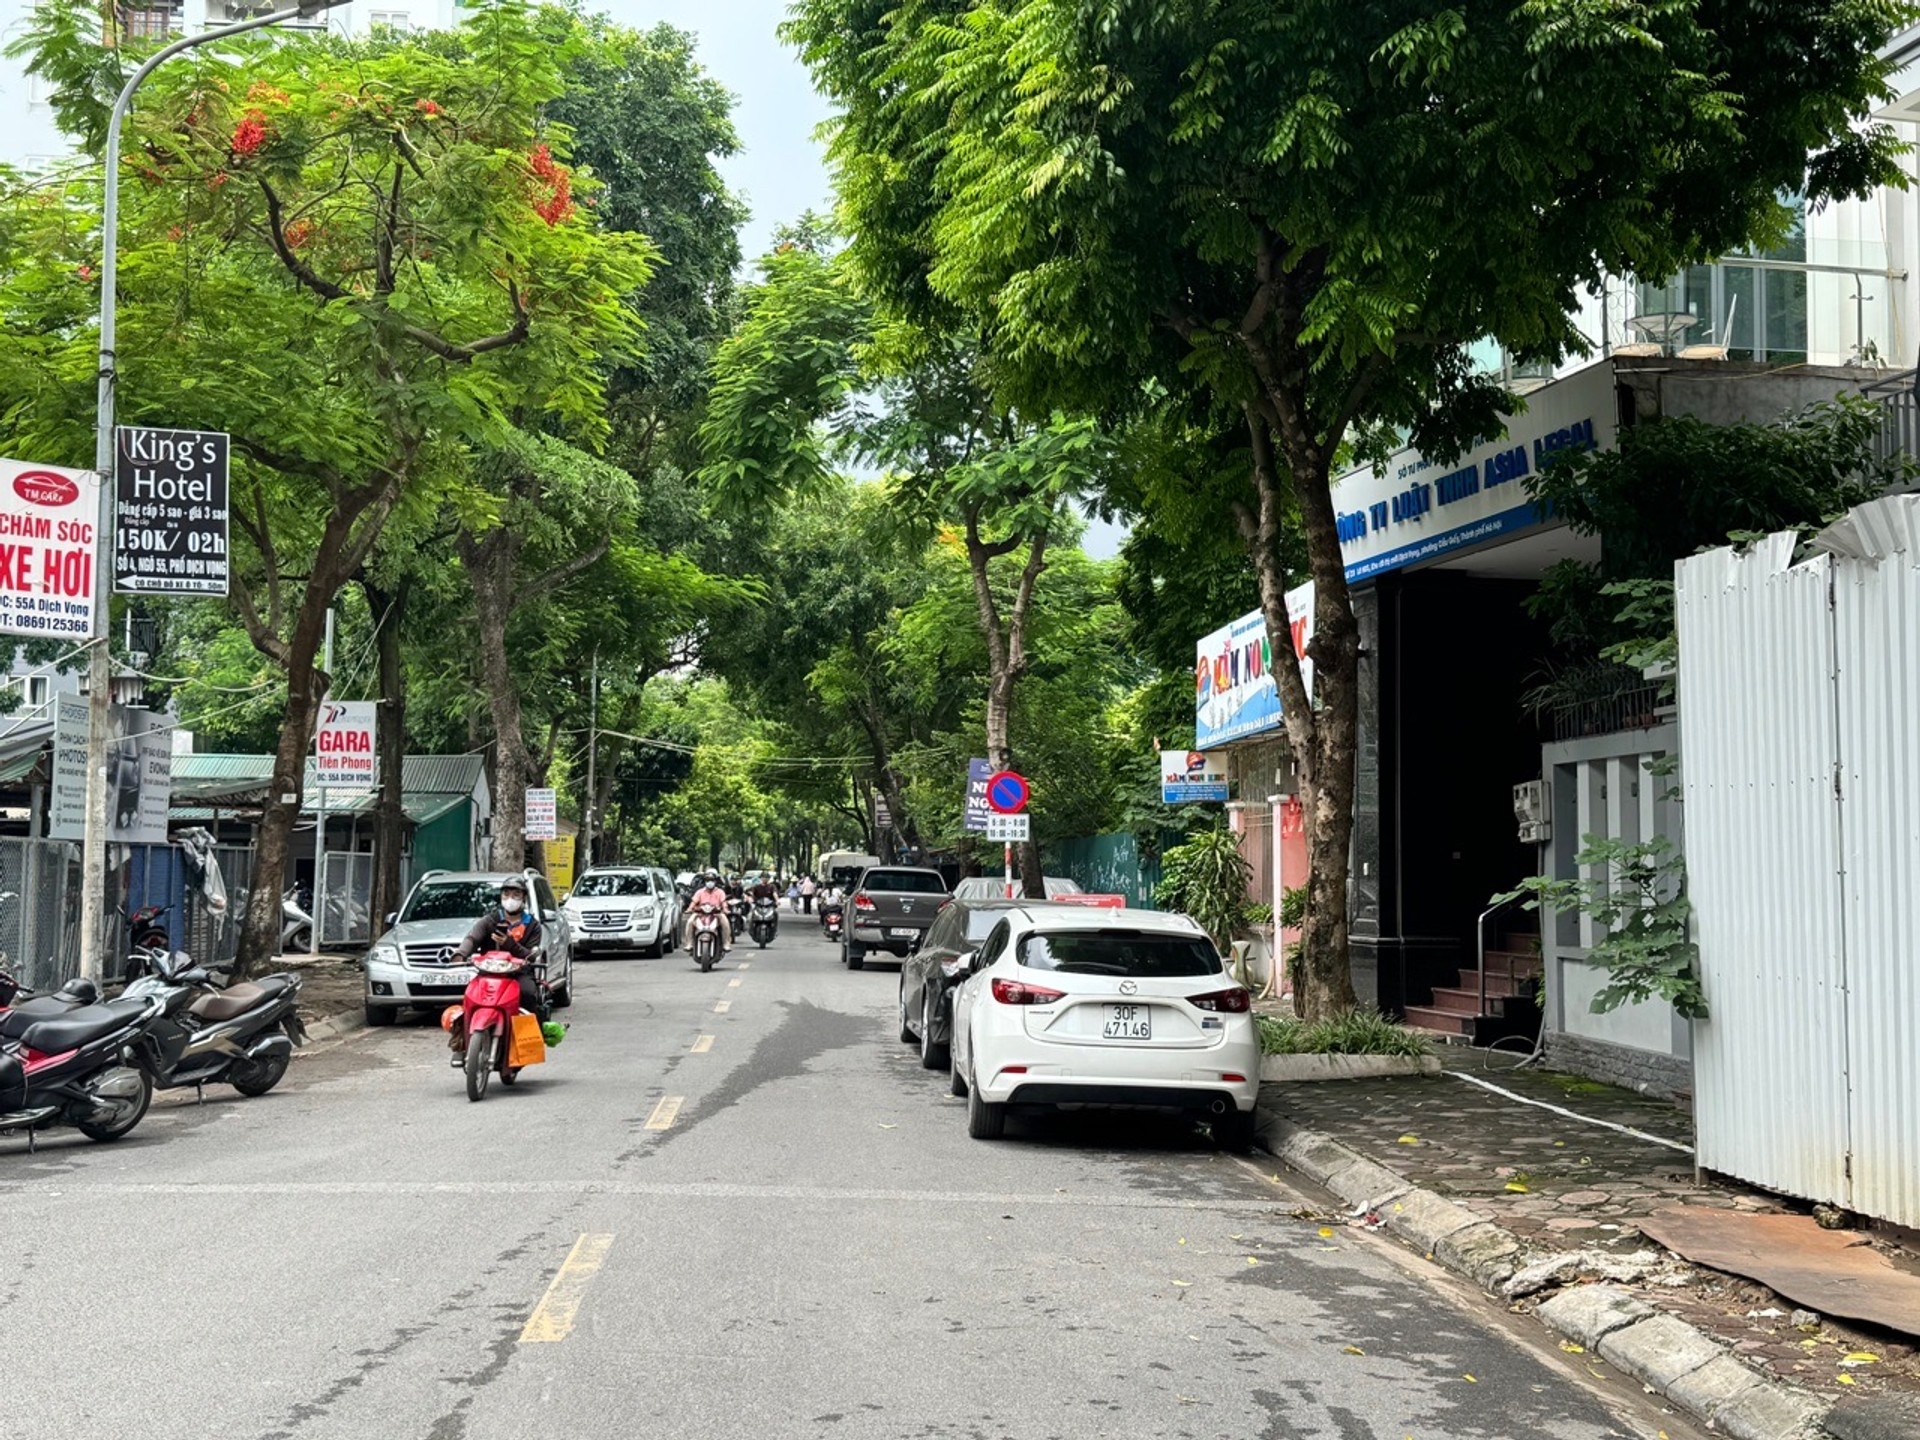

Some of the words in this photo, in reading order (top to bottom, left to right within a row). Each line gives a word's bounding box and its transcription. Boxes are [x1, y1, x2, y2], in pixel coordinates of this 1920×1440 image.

[131, 430, 216, 471] King's
[134, 469, 212, 501] Hotel
[1337, 511, 1366, 543] ÔNG
[1369, 501, 1388, 532] TY
[1391, 482, 1430, 523] LUẬT
[1434, 465, 1480, 507] TNHH
[1484, 445, 1529, 489] ASIA
[159, 504, 165, 516] 5
[167, 507, 182, 518] sao
[189, 506, 203, 521] giá
[204, 506, 210, 518] 3
[0, 512, 52, 539] CHĂM
[57, 518, 92, 544] SÓC
[188, 531, 225, 553] 02h
[0, 544, 33, 591] XE
[43, 548, 91, 598] HƠI
[117, 552, 128, 571] SỐ
[156, 559, 168, 574] 55,
[170, 554, 185, 573] PHỐ
[186, 560, 205, 577] DỊCH
[15, 596, 35, 611] 55A
[39, 599, 61, 614] Dịch
[64, 601, 89, 617] Vọng
[16, 615, 88, 633] 0869125366
[319, 730, 371, 752] GARA
[341, 756, 372, 771] Phong
[1114, 1006, 1138, 1020] 30F
[1105, 1022, 1149, 1037] 471.46
